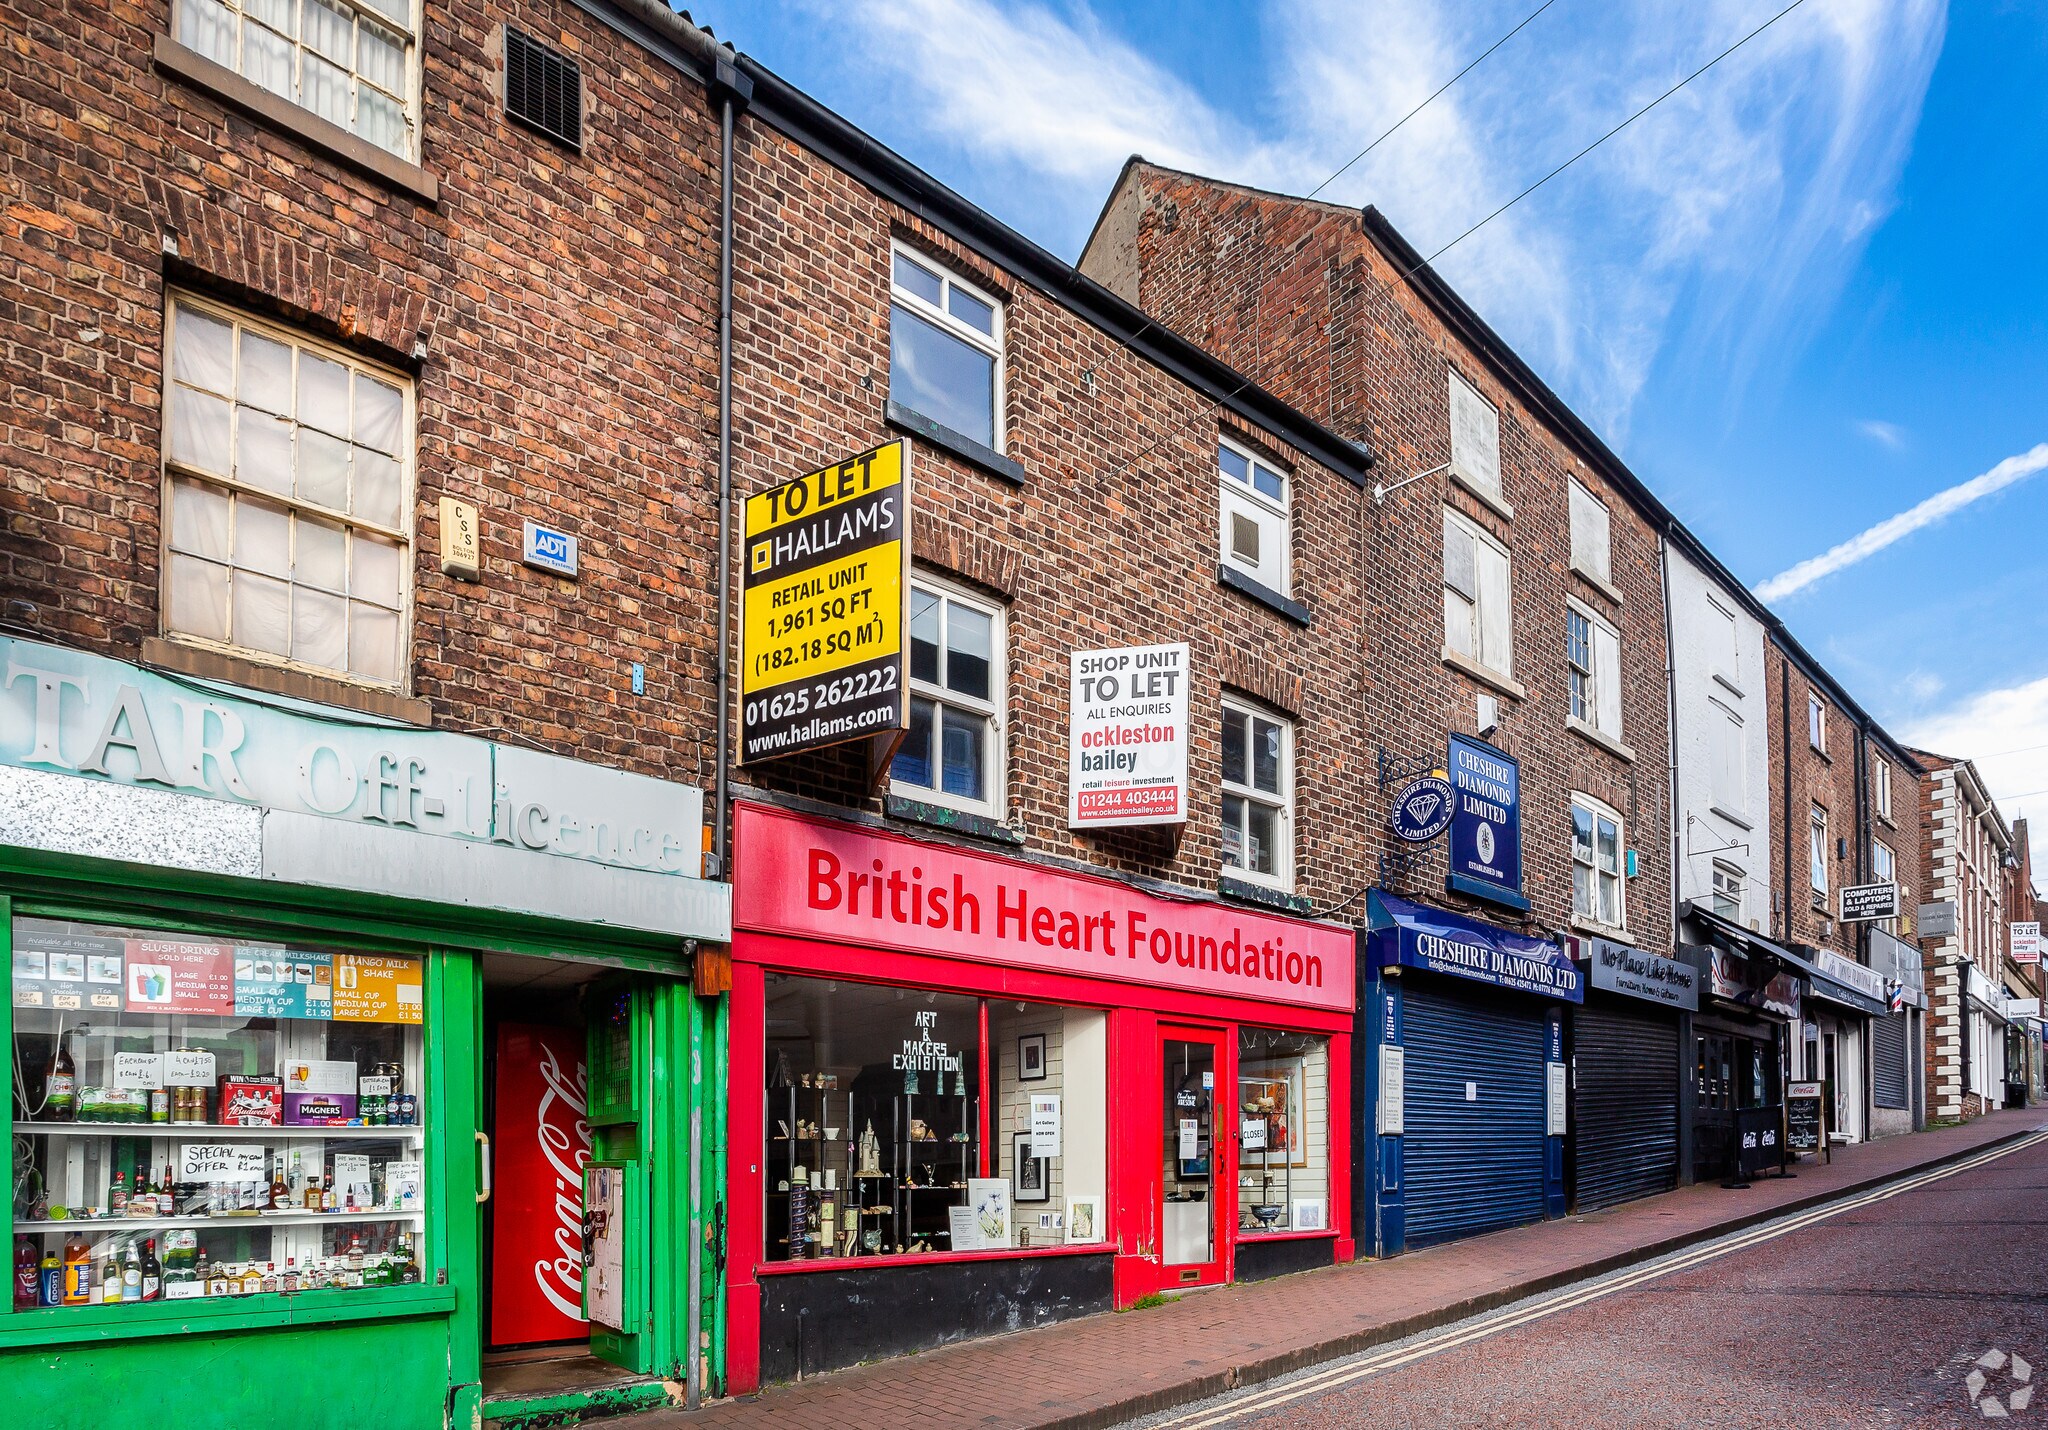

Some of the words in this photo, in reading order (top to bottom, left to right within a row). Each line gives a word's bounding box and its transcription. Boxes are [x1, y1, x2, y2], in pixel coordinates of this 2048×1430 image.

[766, 478, 809, 525] TO
[817, 452, 877, 511] LET
[775, 497, 895, 566] HALLAMS
[536, 534, 567, 558] ADT
[771, 579, 826, 609] RETAIL
[828, 562, 869, 592] UNIT
[767, 607, 815, 640] 1,961
[821, 596, 846, 626] SQ
[849, 588, 873, 614] FT
[754, 636, 822, 678] (182.18
[826, 629, 851, 659] SQ
[1079, 655, 1130, 674] SHOP
[1135, 650, 1180, 669] UNIT
[1080, 674, 1120, 703] TO
[1132, 671, 1180, 697] LET
[745, 688, 810, 727] 01625
[814, 665, 897, 712] 262222
[1086, 707, 1107, 721] ALL
[1108, 702, 1172, 720] ENQUIRIES
[748, 703, 894, 755] www.hallams.com
[1081, 724, 1175, 748] ockleston
[1080, 749, 1138, 774] bailey
[1458, 749, 1509, 785] CHESHIRE
[1081, 779, 1103, 789] retail
[1104, 778, 1131, 788] leisure
[1132, 775, 1175, 786] investment
[1457, 770, 1511, 806] DIAMONDS
[1080, 793, 1122, 808] 01244
[1126, 789, 1176, 805] 403444
[1394, 783, 1422, 825] CHESHIRE
[1422, 781, 1452, 813] DIAMONDS
[299, 743, 683, 873] Off-Licence
[1080, 804, 1176, 819] www.ocklestonbailey.co.uk
[1463, 794, 1507, 825] LIMITED
[1404, 822, 1440, 838] LIMITED
[1468, 861, 1496, 877] ESTABLISHED
[1844, 886, 1894, 898] COMPUTERS
[1854, 894, 1892, 905] LAPTOPS
[1866, 902, 1894, 910] REPAIRED
[807, 847, 981, 936] British
[996, 883, 1117, 957] Heart
[1126, 909, 1324, 988] Foundation
[28, 938, 61, 946] Available
[141, 943, 177, 953] SLUSH
[180, 945, 220, 956] DRINKS
[158, 954, 180, 962] SOLD
[183, 955, 204, 963] HERE
[237, 948, 252, 956] ICE
[254, 948, 282, 958] CREAM
[285, 952, 331, 962] MILKSHAKE
[347, 956, 383, 967] MANGO
[386, 960, 409, 969] MILK
[1416, 933, 1488, 970] CHESHIRE
[1491, 951, 1553, 985] DIAMONDS
[1556, 967, 1577, 990] LTD
[363, 969, 395, 979] SHAKE
[1428, 959, 1496, 982] info@cheshirediamonds.com
[1601, 944, 1617, 968] No
[1617, 949, 1646, 976] Place
[1646, 957, 1667, 981] Like
[1666, 964, 1693, 989] Home
[17, 983, 40, 991] Coffee
[51, 988, 84, 996] Chocolate
[174, 981, 207, 989] MEDIUM
[235, 986, 267, 995] SMALL
[268, 988, 286, 996] CUP
[175, 991, 201, 999] SMALL
[235, 996, 275, 1005] MEDIUM
[277, 998, 294, 1006] CUP
[305, 1000, 331, 1008] £1.00
[333, 990, 361, 999] SMALL
[364, 992, 380, 1000] CUP
[235, 1005, 265, 1014] LARGE
[305, 1008, 331, 1017] £1.50
[333, 999, 370, 1008] MEDIUM
[371, 1001, 388, 1009] CUP
[333, 1009, 360, 1017] LARGE
[362, 1010, 379, 1018] CUP
[398, 1012, 422, 1020] £1.50
[915, 1011, 937, 1028] ART
[903, 1039, 947, 1057] MAKERS
[893, 1053, 959, 1072] EXHIBITON
[301, 1106, 340, 1115] MAGNERS
[1243, 1129, 1264, 1139] CLOSED
[188, 1146, 236, 1161] SPECIAL
[186, 1161, 229, 1174] OFFER
[51, 1275, 59, 1300] BOOST
